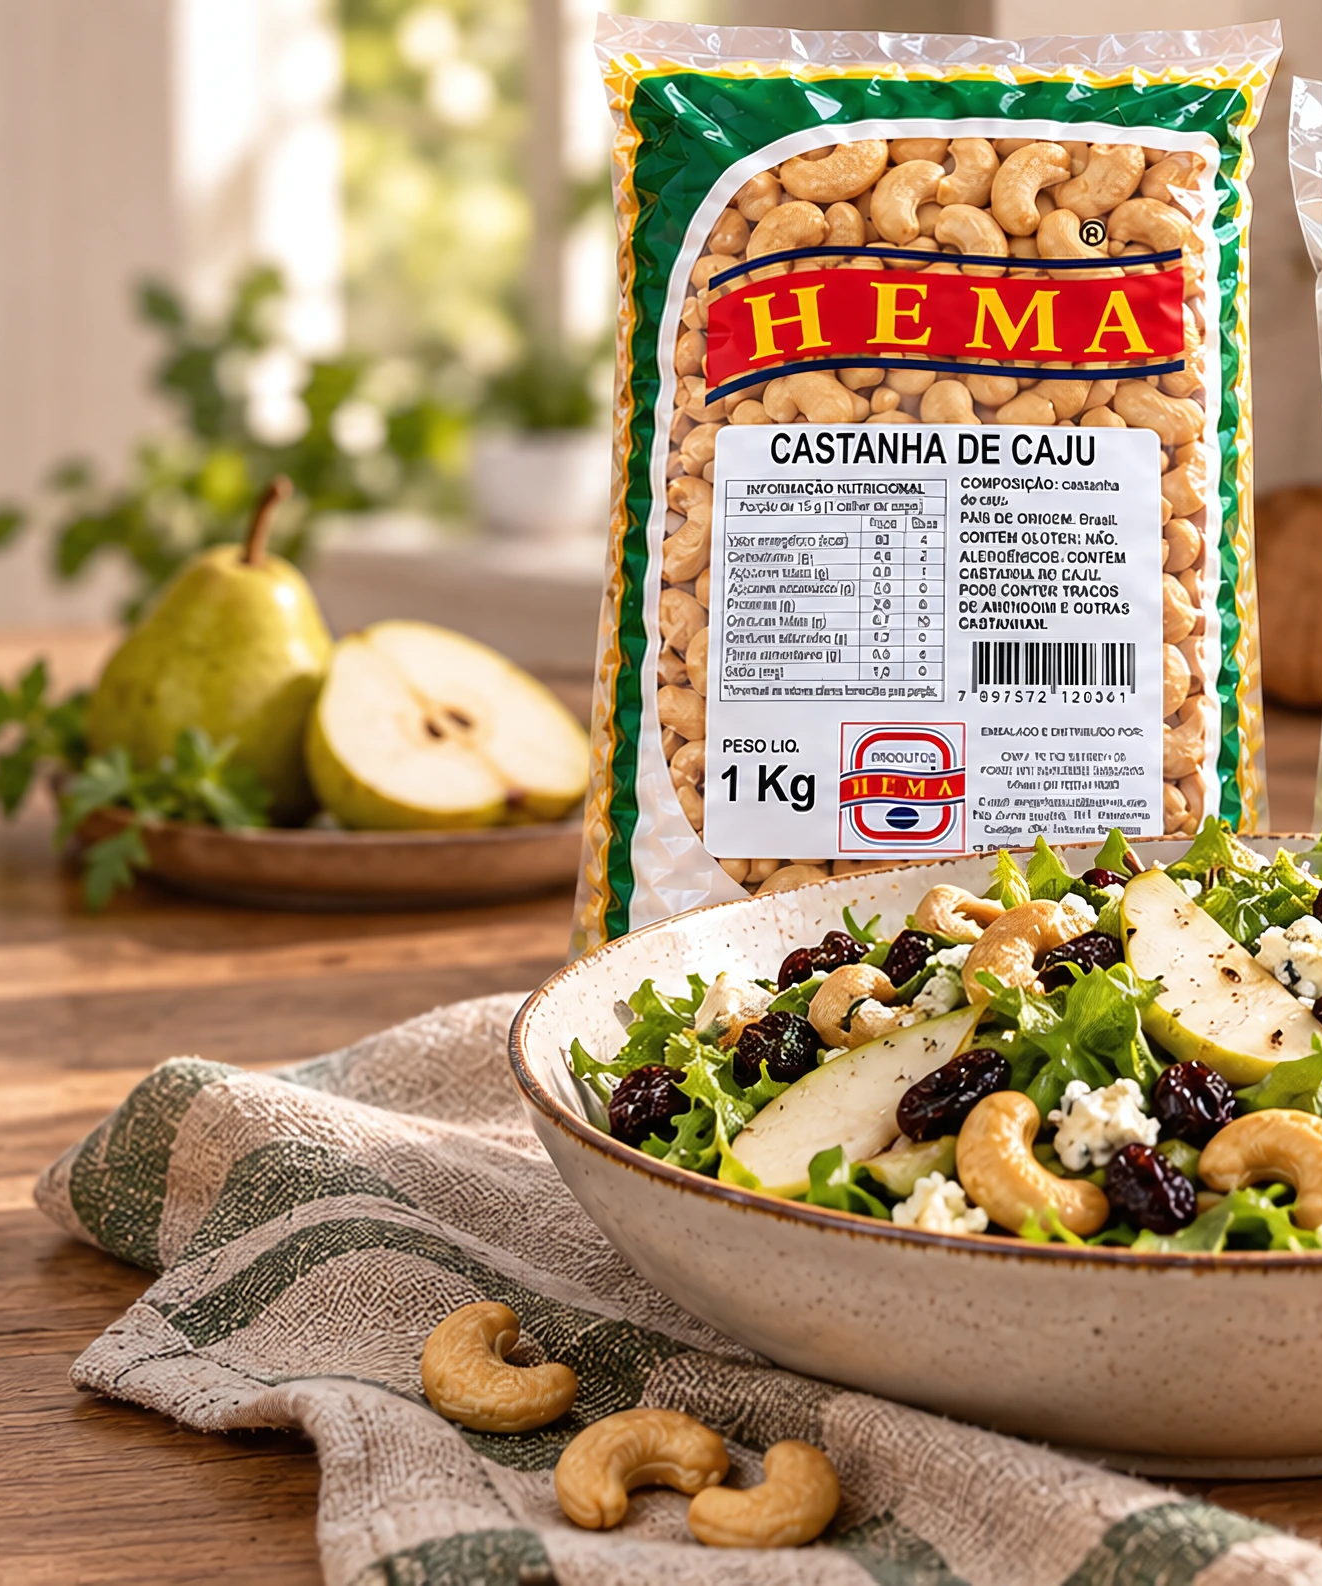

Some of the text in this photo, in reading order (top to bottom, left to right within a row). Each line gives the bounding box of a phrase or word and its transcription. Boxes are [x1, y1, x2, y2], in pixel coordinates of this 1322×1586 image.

[743, 283, 1154, 361] HEMA
[770, 432, 1096, 466] CASTANHA DE CAJU
[722, 738, 767, 753] PESO
[721, 764, 816, 812] 1 Kg
